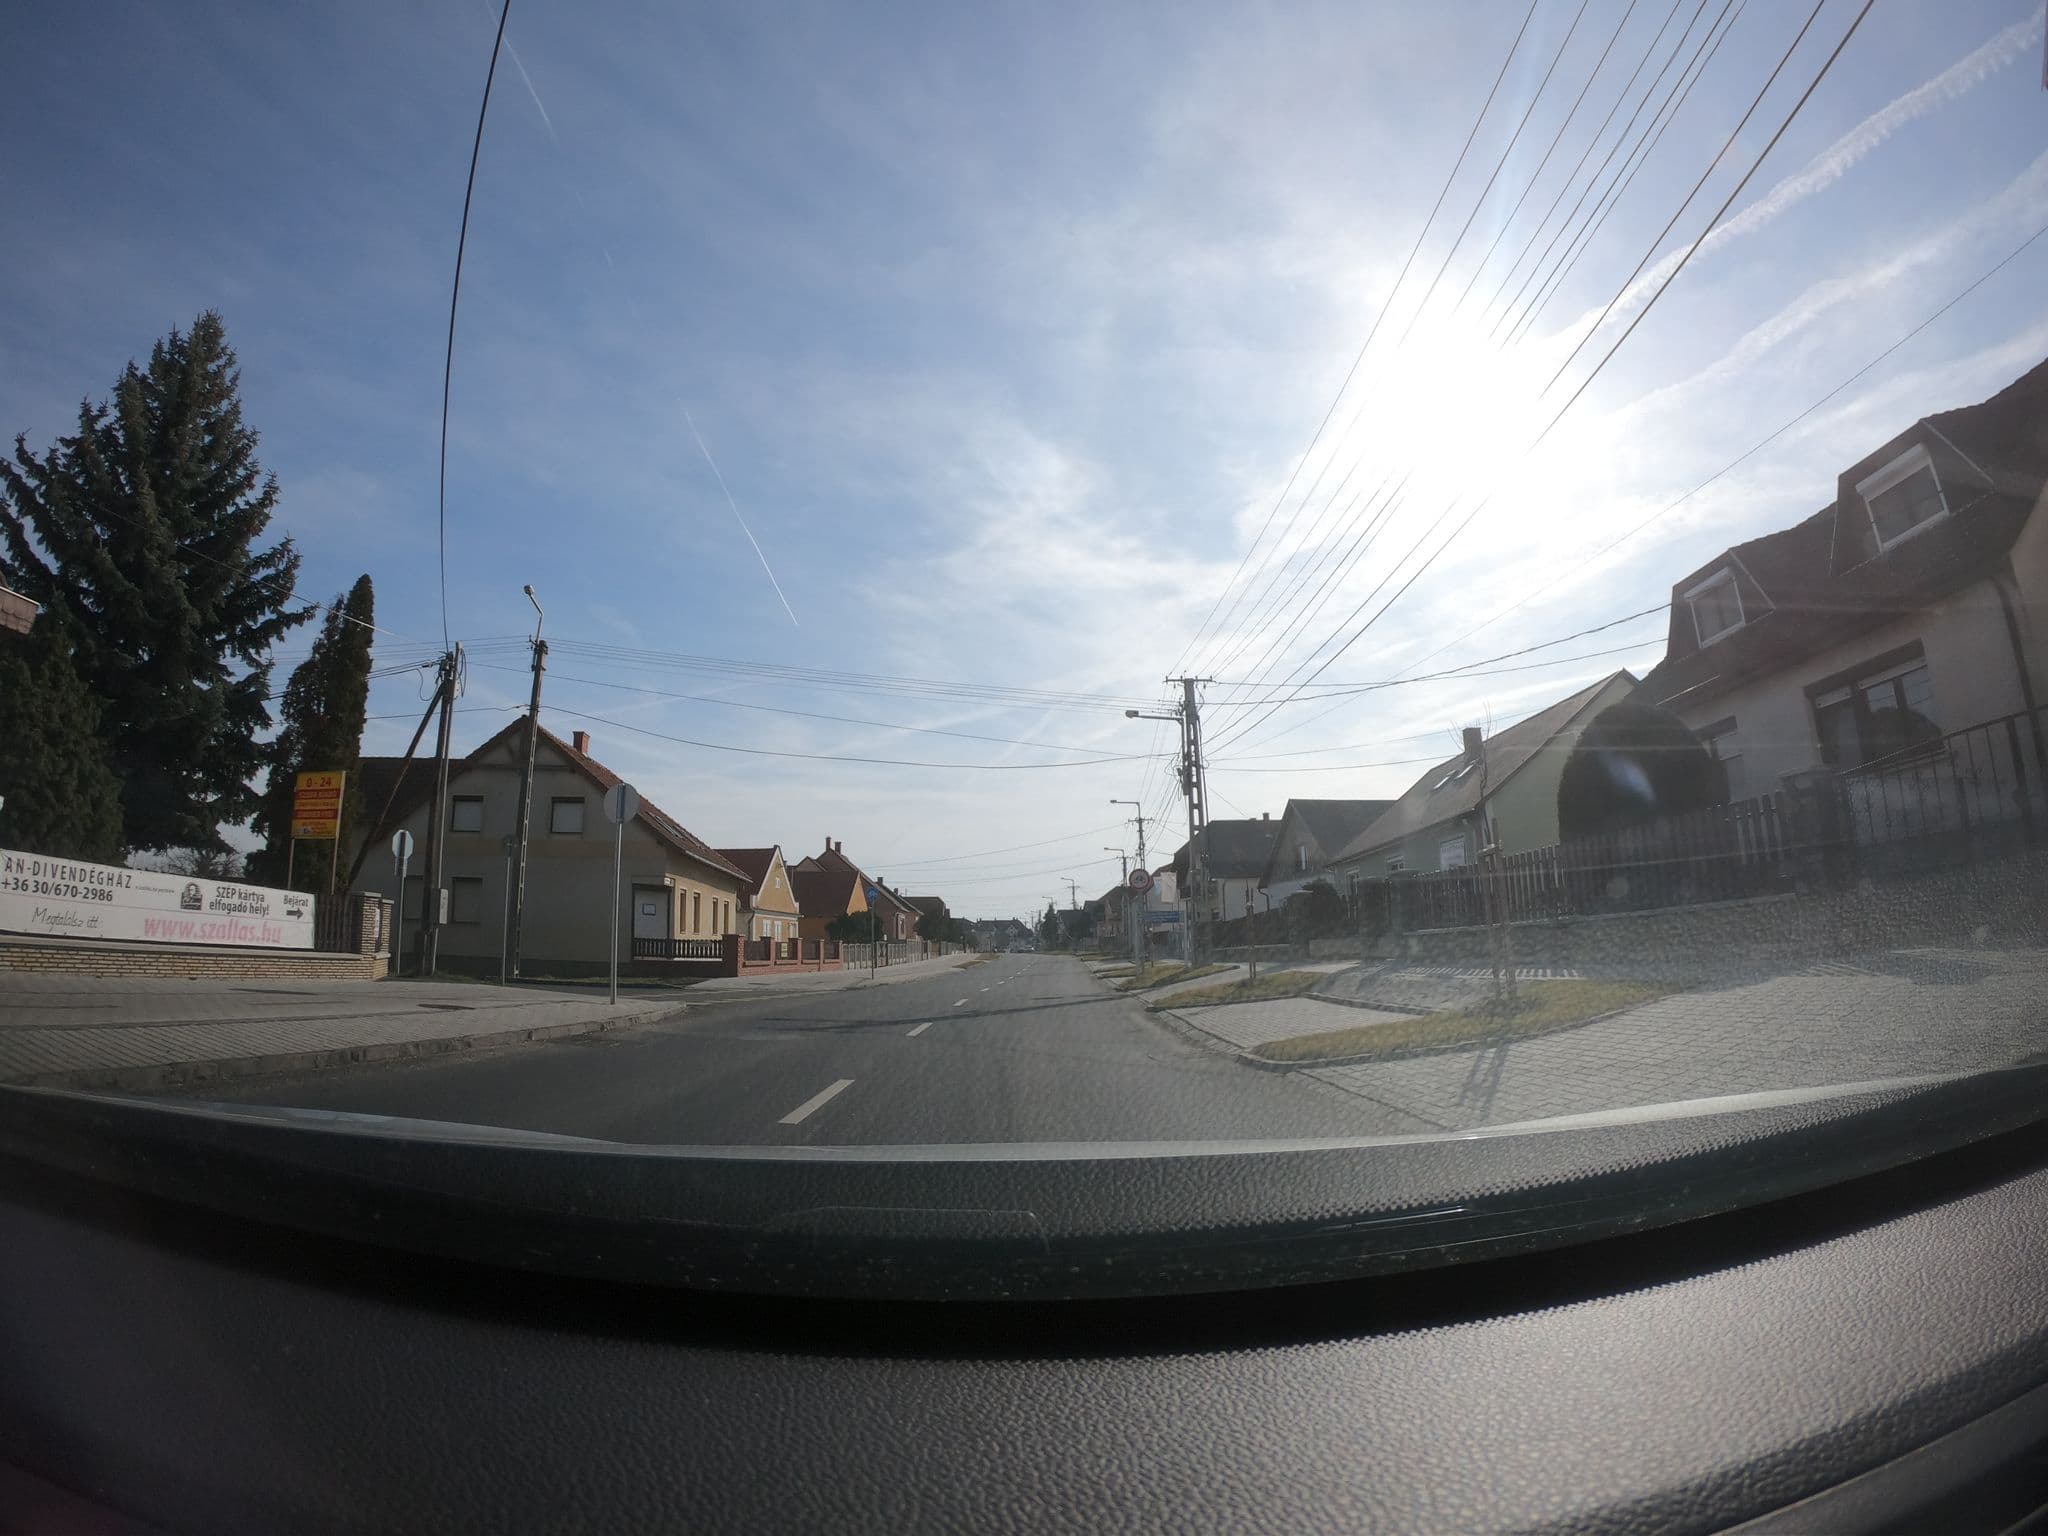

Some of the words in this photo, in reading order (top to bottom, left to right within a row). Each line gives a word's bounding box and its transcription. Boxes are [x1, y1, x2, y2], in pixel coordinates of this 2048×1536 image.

[32, 880, 113, 902] 30/670-2986
[249, 903, 269, 917] hely!
[144, 917, 281, 943] www.szallas.hu
